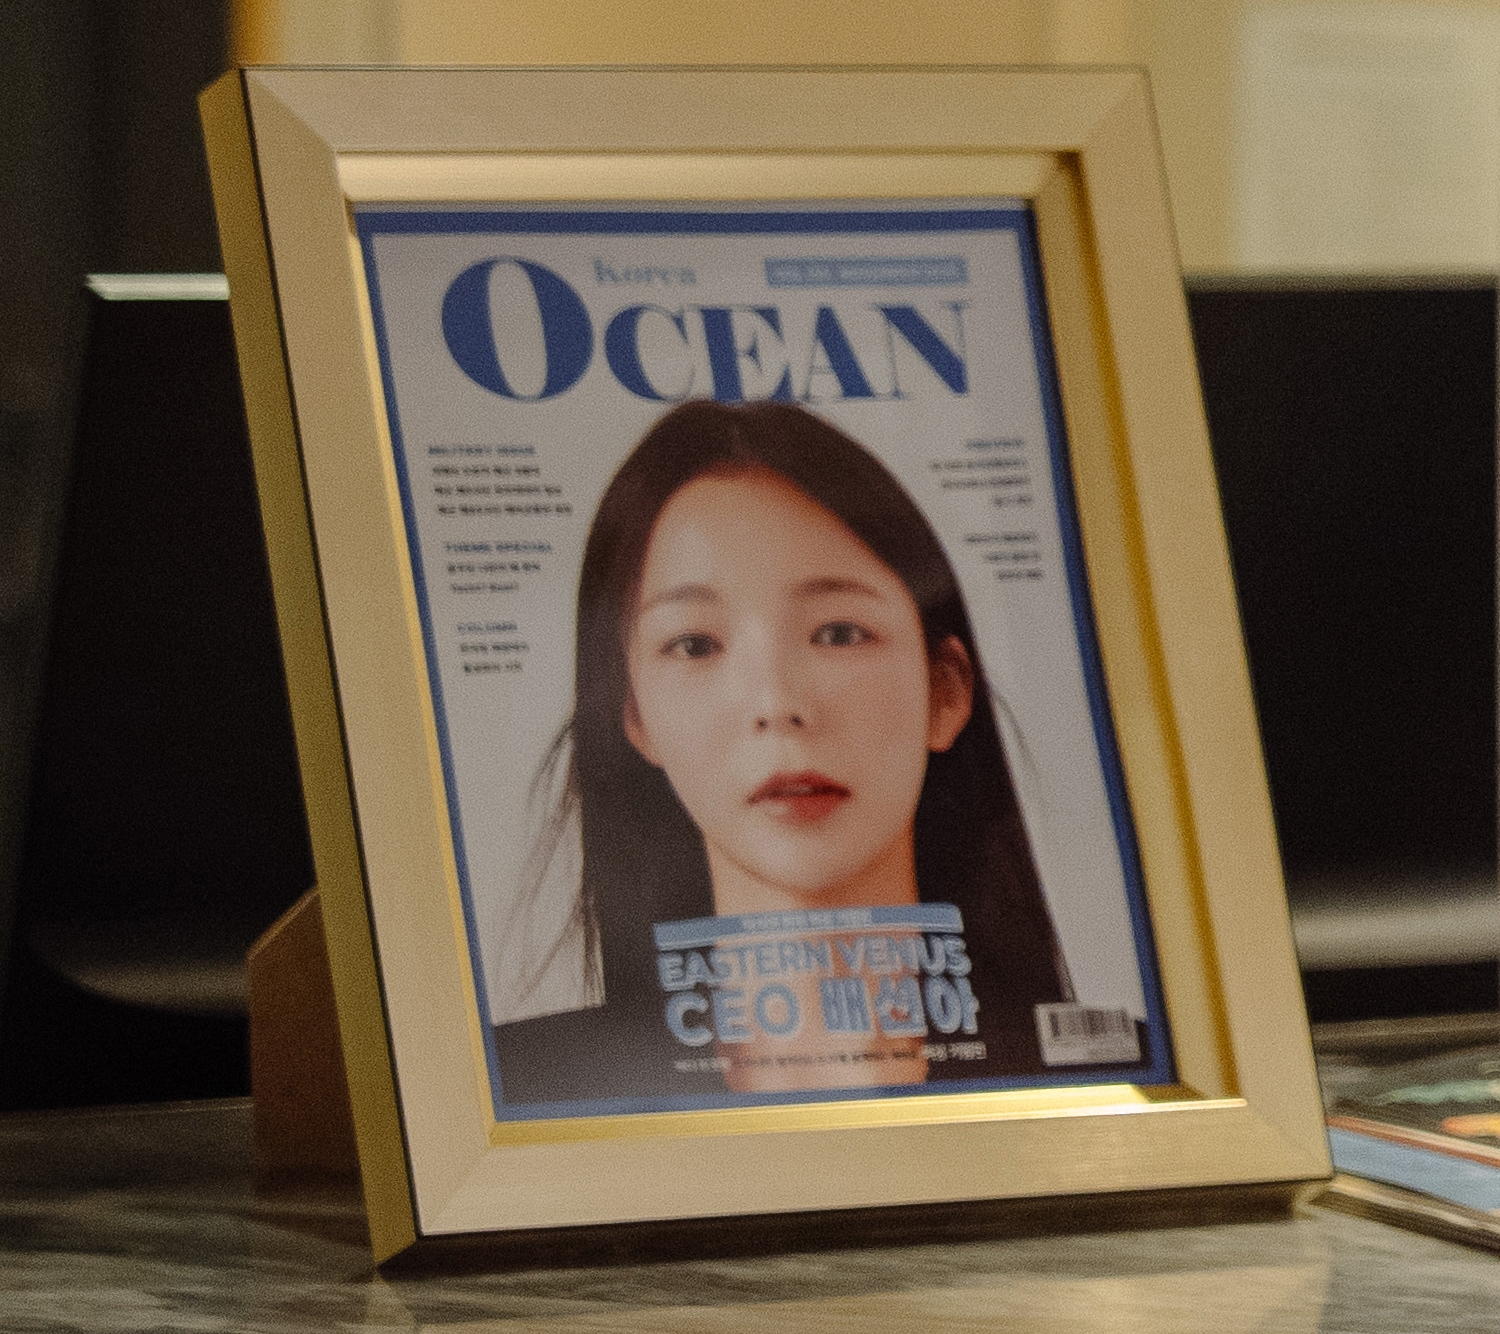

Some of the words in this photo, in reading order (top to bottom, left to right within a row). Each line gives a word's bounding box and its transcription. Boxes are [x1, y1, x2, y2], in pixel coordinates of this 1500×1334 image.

[441, 254, 969, 403] OCEAN
[656, 938, 835, 992] EASTERN
[836, 933, 972, 977] VENUS
[665, 982, 801, 1047] CEO
